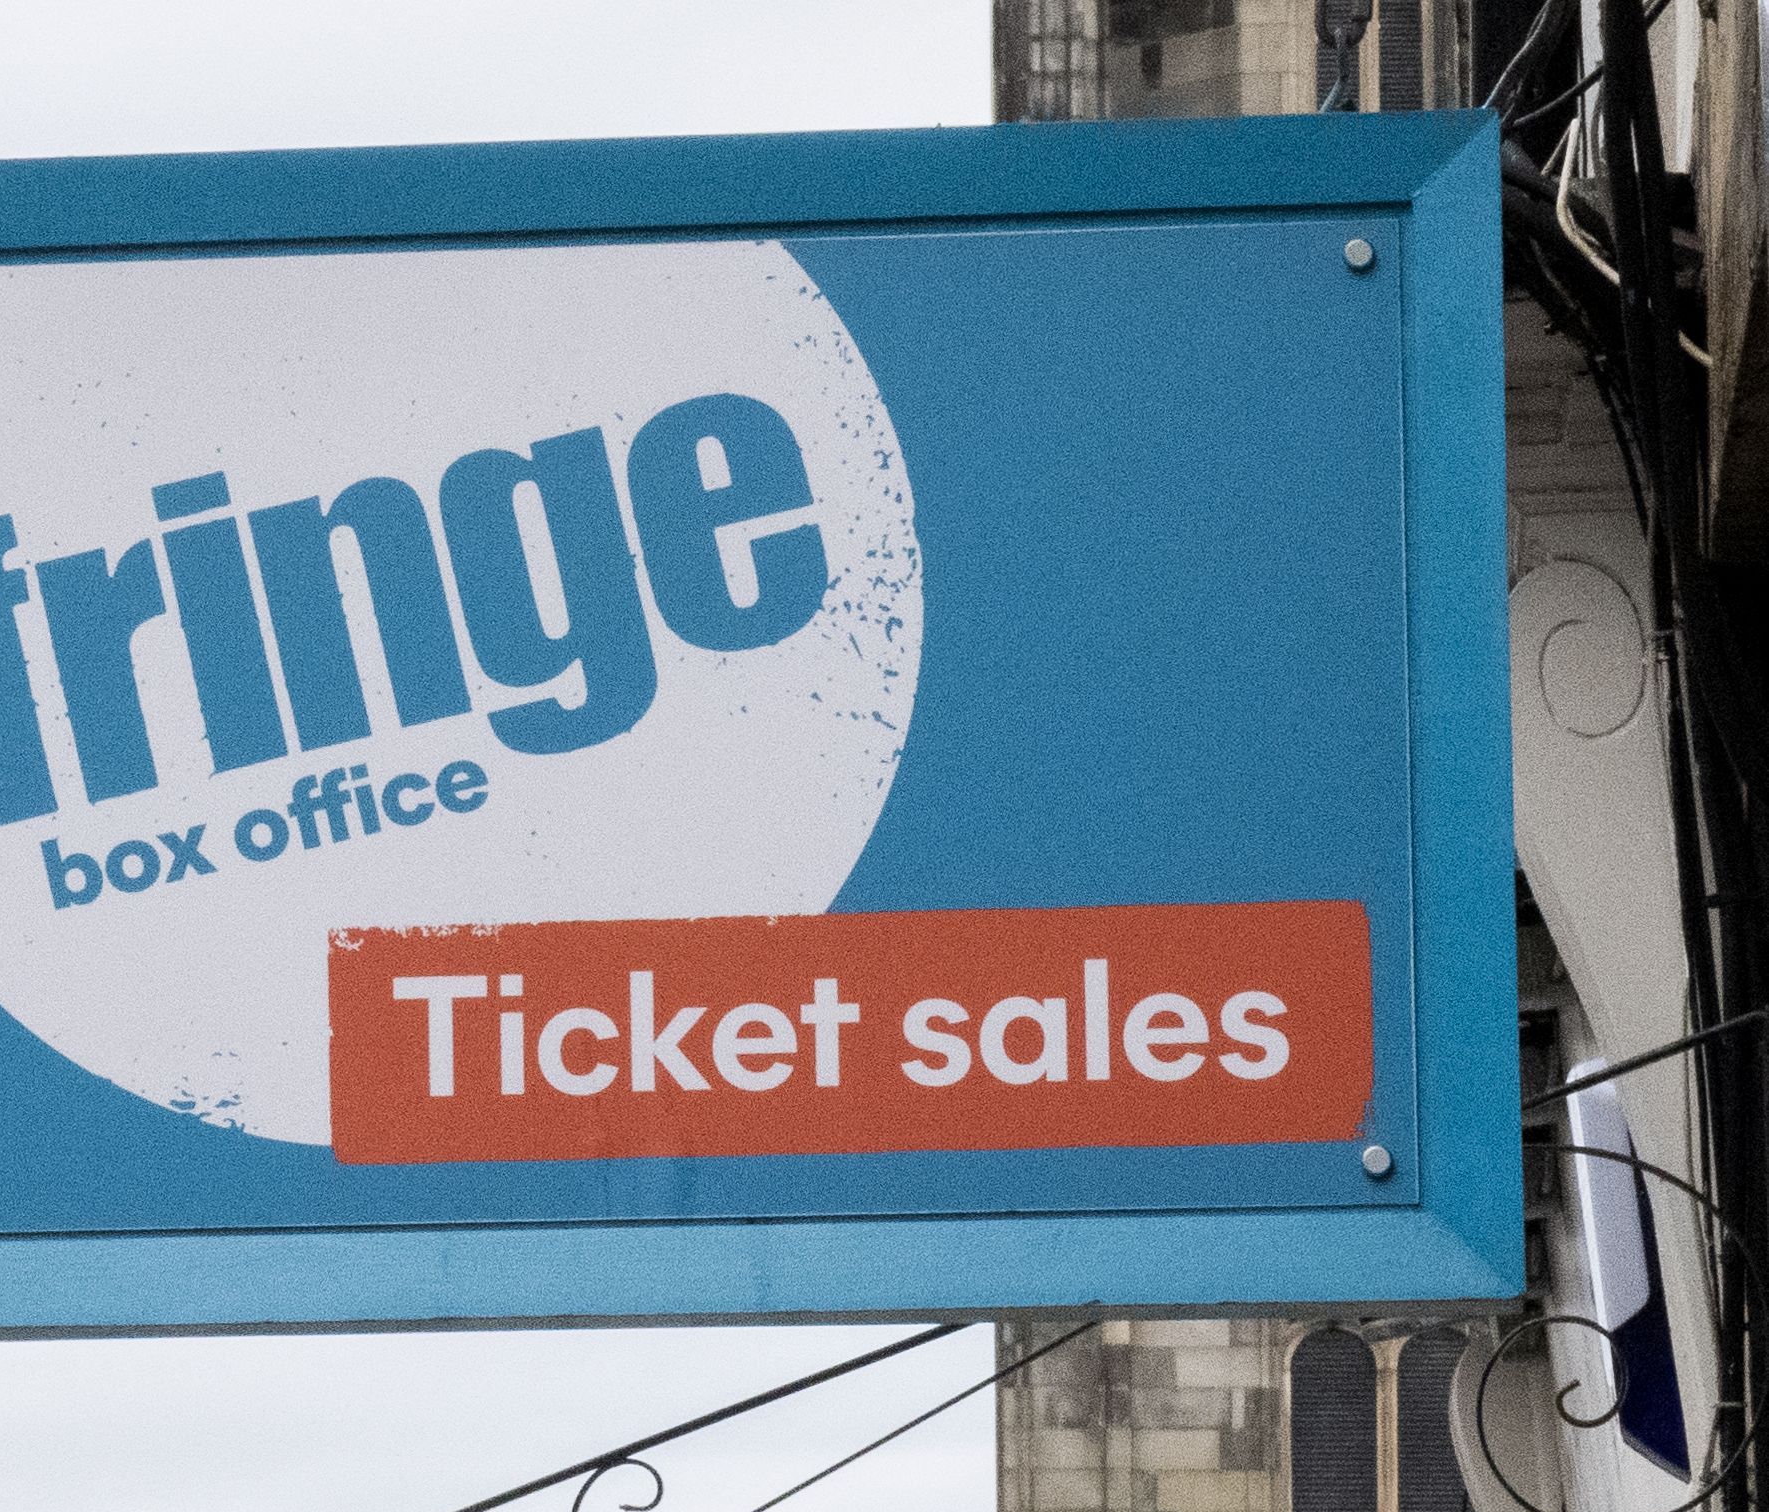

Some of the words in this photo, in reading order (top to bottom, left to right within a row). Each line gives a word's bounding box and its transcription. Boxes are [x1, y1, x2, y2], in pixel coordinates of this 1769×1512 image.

[42, 827, 214, 908] box
[236, 762, 486, 860] office
[394, 971, 859, 1096] Ticket
[903, 960, 1289, 1086] sales
